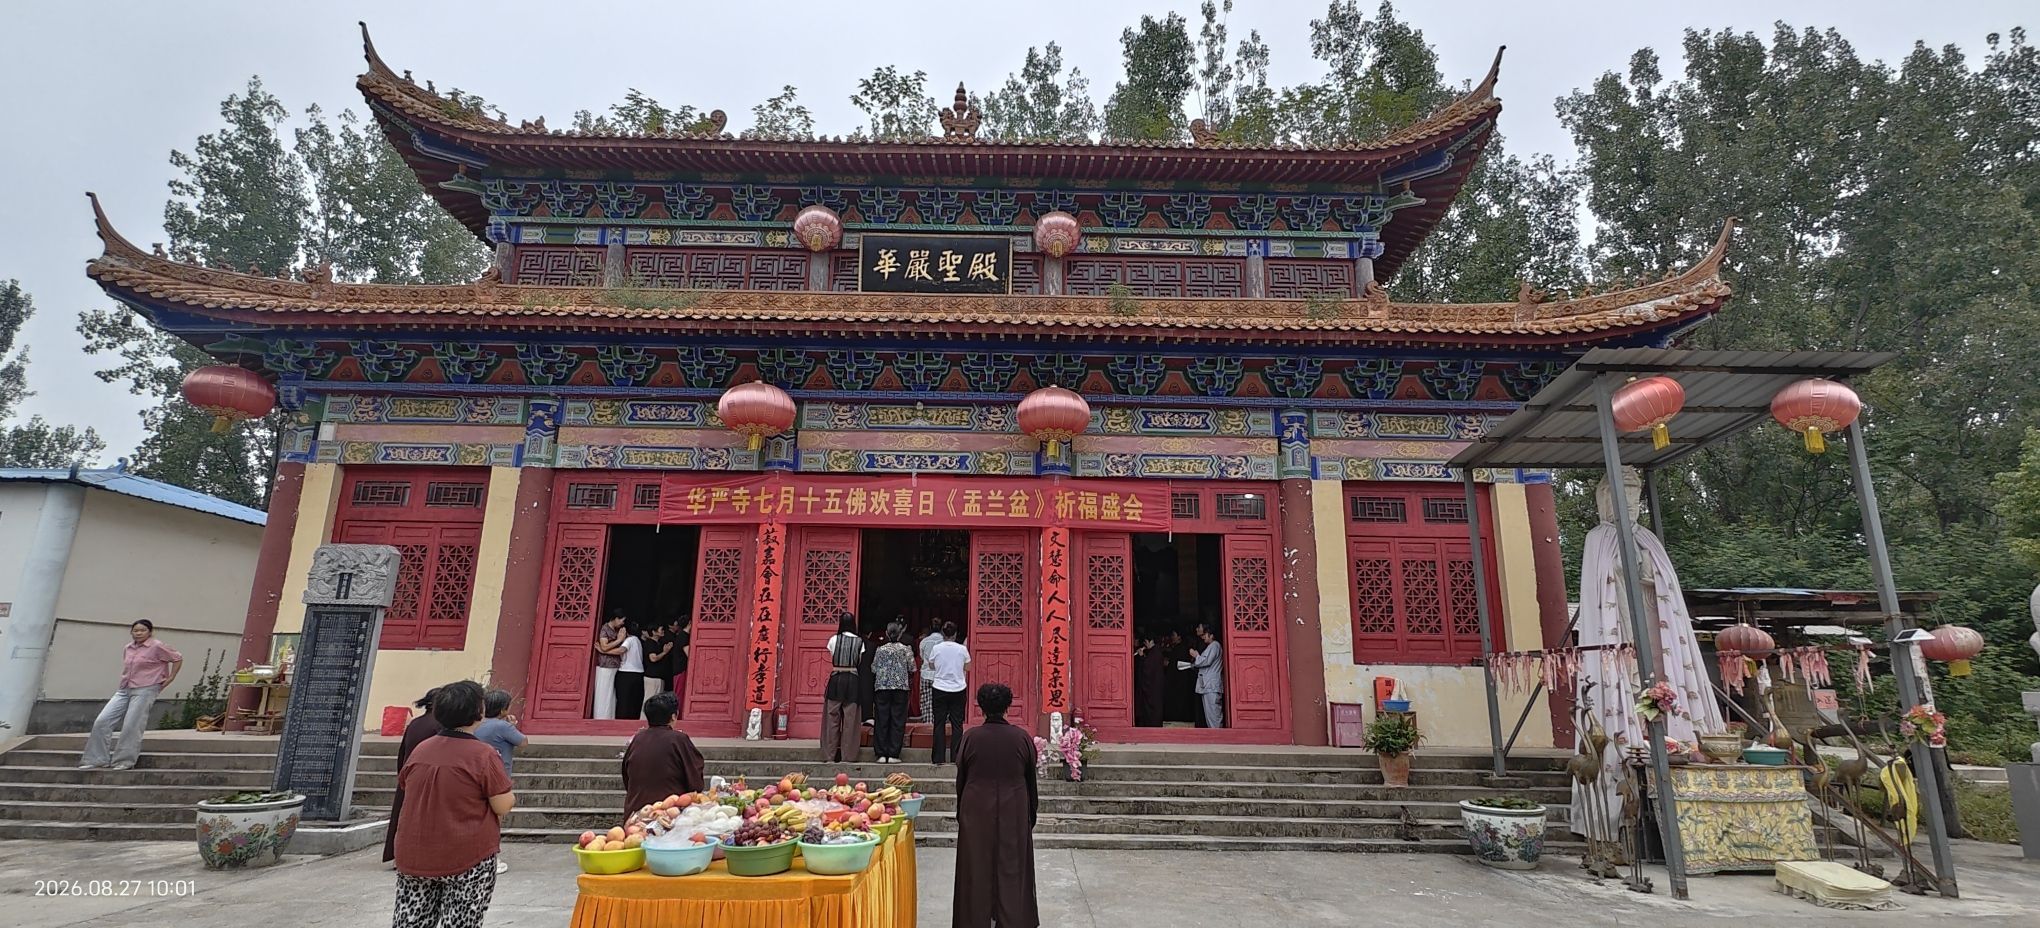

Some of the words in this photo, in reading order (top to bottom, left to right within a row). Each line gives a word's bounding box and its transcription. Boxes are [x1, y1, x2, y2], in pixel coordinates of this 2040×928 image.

[872, 248, 1000, 282] 華嚴聖殿
[686, 486, 1144, 521] 华严寺七月十五佛欢喜日《盂兰盆》祈福盛会
